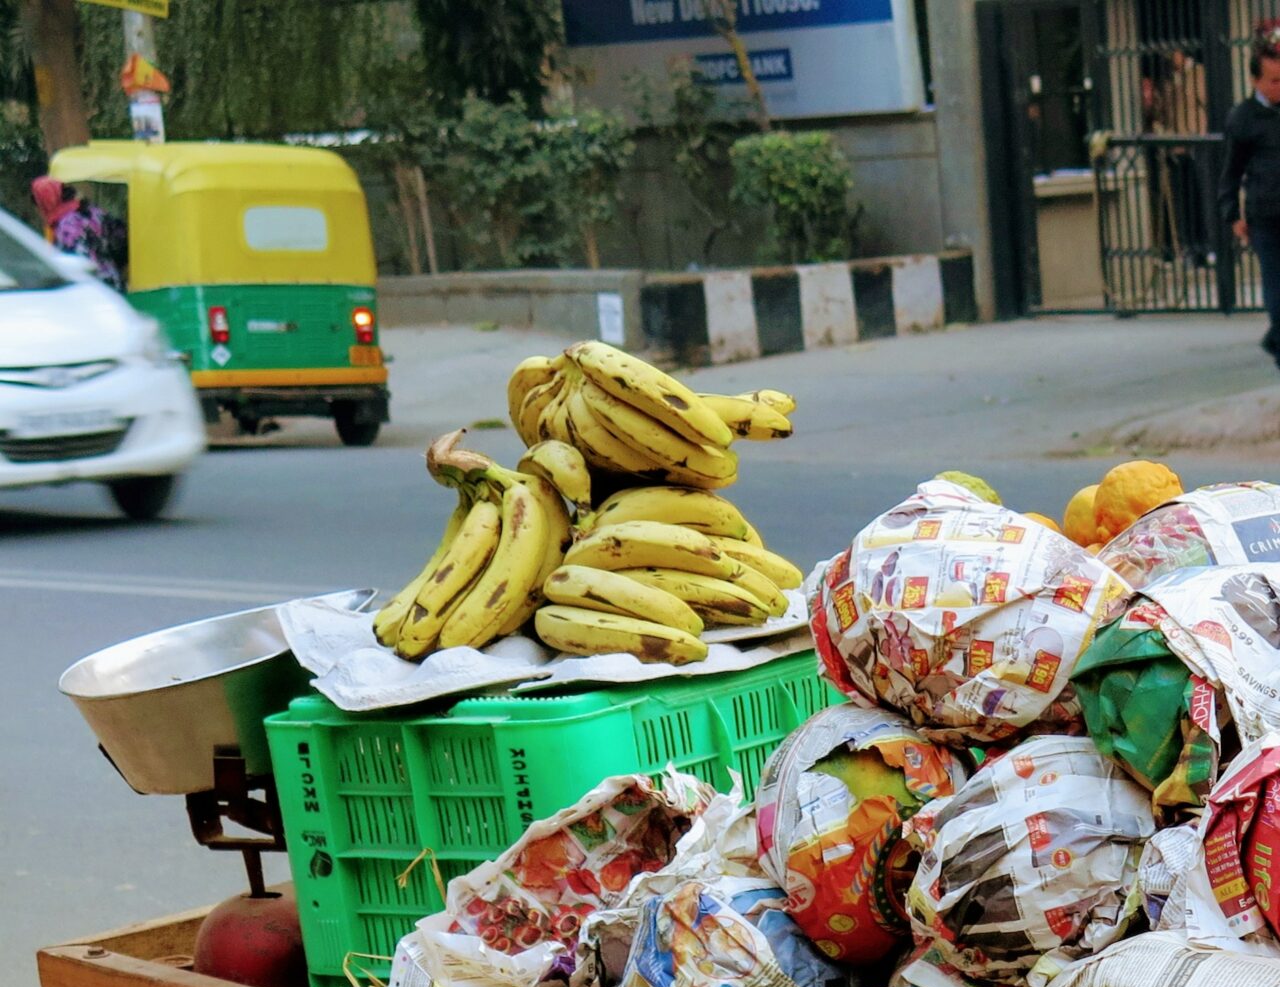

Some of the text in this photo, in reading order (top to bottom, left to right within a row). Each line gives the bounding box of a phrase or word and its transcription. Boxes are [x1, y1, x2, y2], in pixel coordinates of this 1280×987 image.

[752, 55, 788, 76] ANK
[1237, 666, 1278, 699] SAVINGS
[509, 748, 534, 831] SHPICK
[1253, 841, 1273, 912] life
